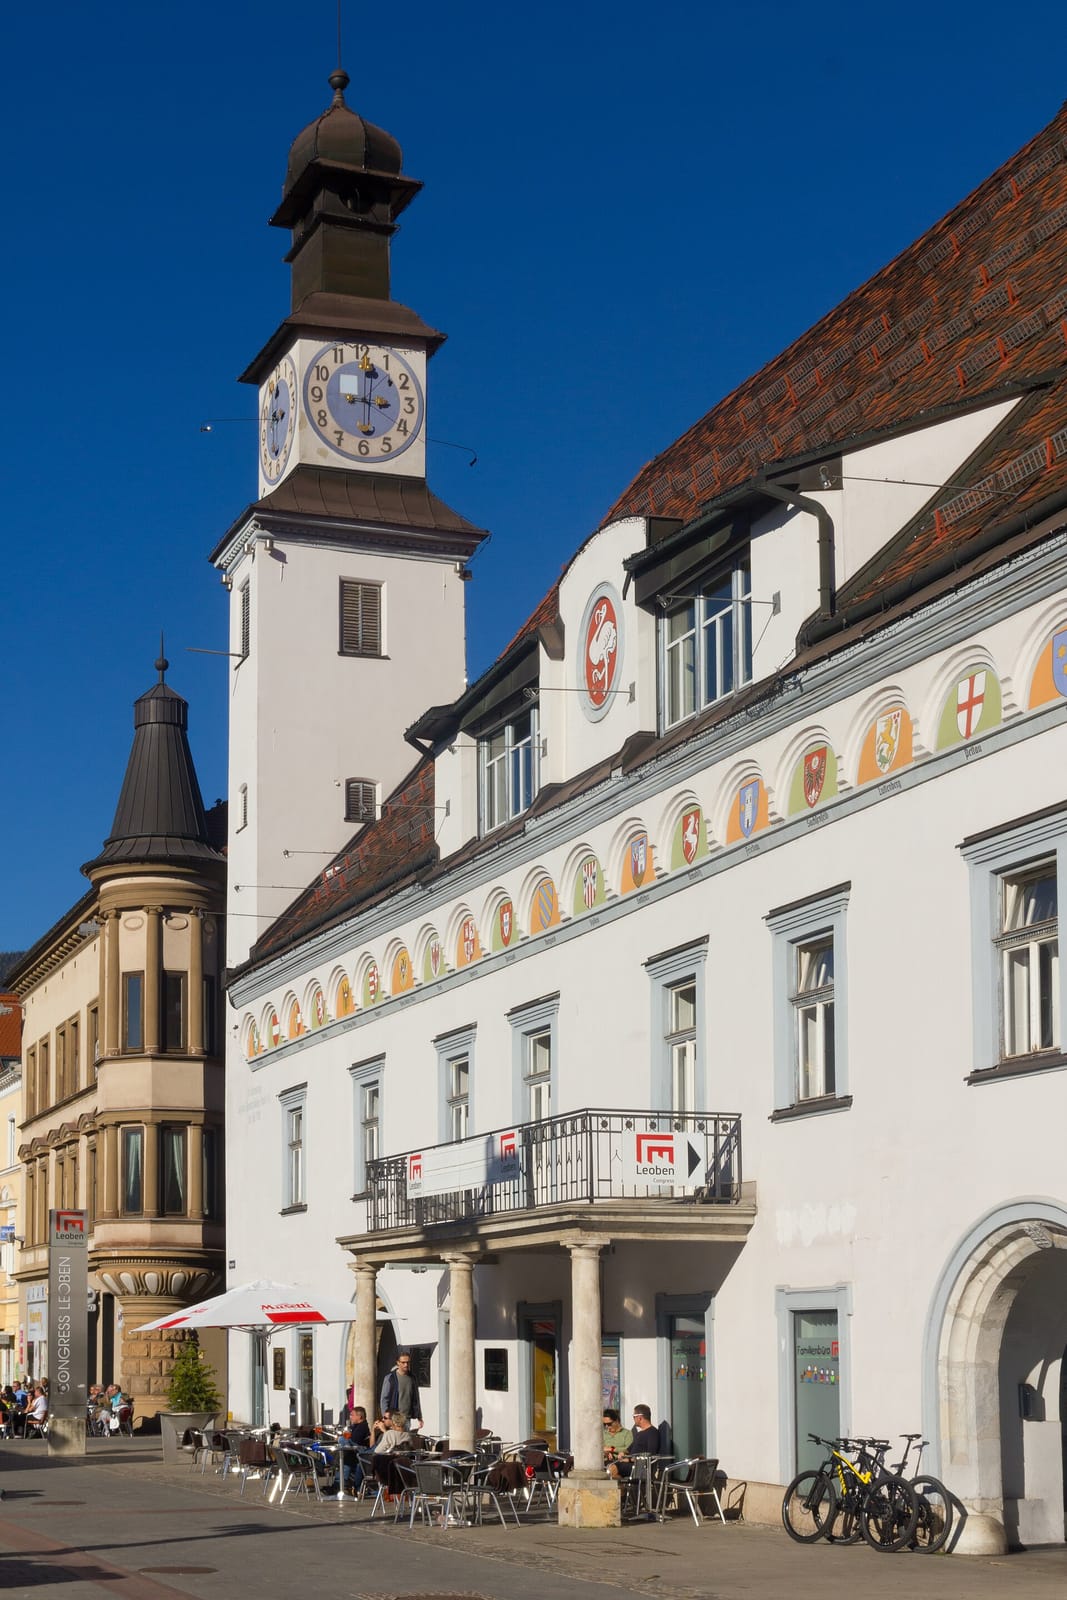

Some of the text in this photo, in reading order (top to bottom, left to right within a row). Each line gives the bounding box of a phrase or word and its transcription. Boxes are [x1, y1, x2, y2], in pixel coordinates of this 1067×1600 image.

[333, 347, 344, 364] 11
[383, 354, 389, 371] 1
[315, 365, 330, 382] 10
[398, 373, 410, 390] 2
[310, 386, 323, 402] 9
[403, 397, 415, 414] 3
[318, 410, 328, 427] 8
[396, 418, 409, 436] 4
[334, 430, 344, 447] 7
[381, 437, 392, 453] 5
[358, 440, 370, 456] 6
[636, 1165, 674, 1175] Leoben
[56, 1232, 84, 1240] Leoben
[58, 1256, 71, 1394] CONGRESS LEOBEN
